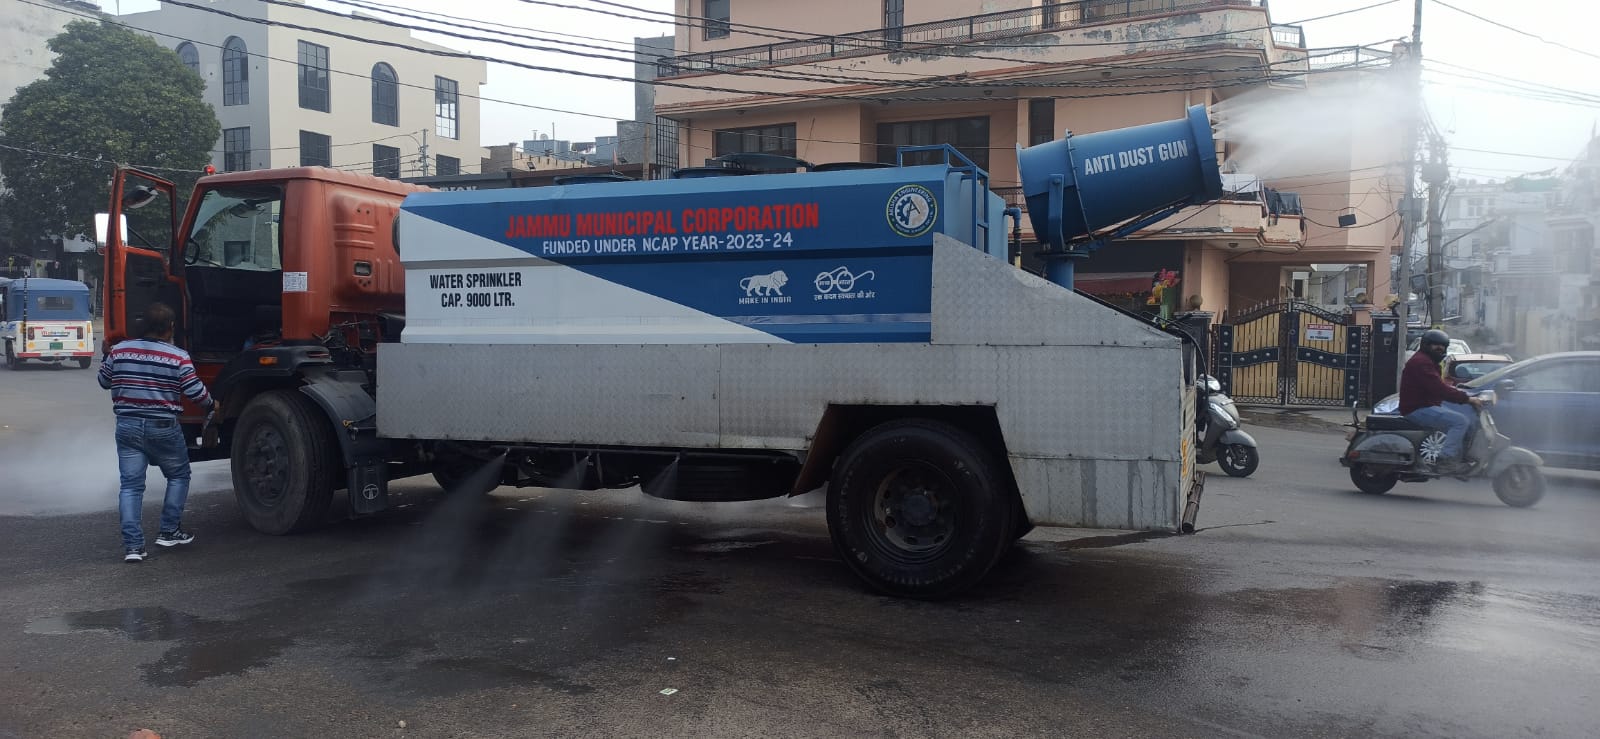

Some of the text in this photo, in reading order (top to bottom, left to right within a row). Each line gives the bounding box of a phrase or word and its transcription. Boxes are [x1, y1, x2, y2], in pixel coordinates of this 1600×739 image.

[1084, 139, 1189, 176] ANTI DUST GUN
[505, 202, 820, 239] JAMMU MUNICIPAL CORPORATION
[542, 231, 794, 255] FUNDED UNDER NCAP YEAR-2023-24
[429, 271, 522, 289] WATER SPRINKLER
[441, 291, 515, 308] CAP. 9000 LTR.
[738, 295, 792, 305] MAKE IN INDIA
